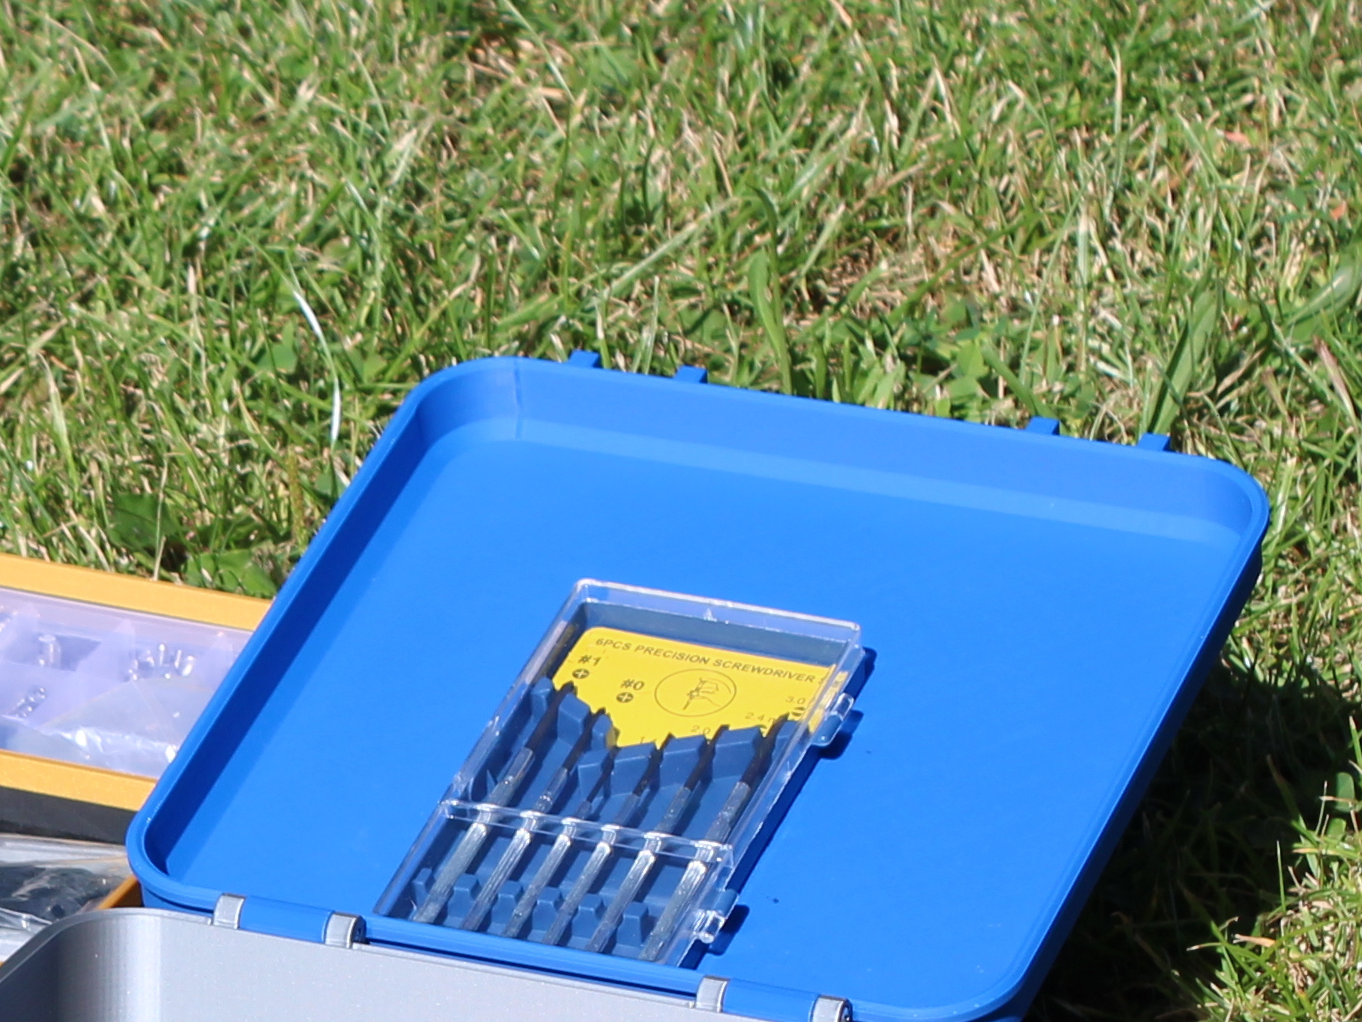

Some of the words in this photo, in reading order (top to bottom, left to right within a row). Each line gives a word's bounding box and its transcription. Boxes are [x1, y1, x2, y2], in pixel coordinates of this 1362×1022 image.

[577, 654, 602, 667] #1
[595, 637, 632, 651] 6PCS
[634, 644, 711, 666] PRECISION
[712, 658, 816, 684] SCREWDRIVER
[620, 678, 646, 691] #0
[785, 695, 806, 705] 3.0
